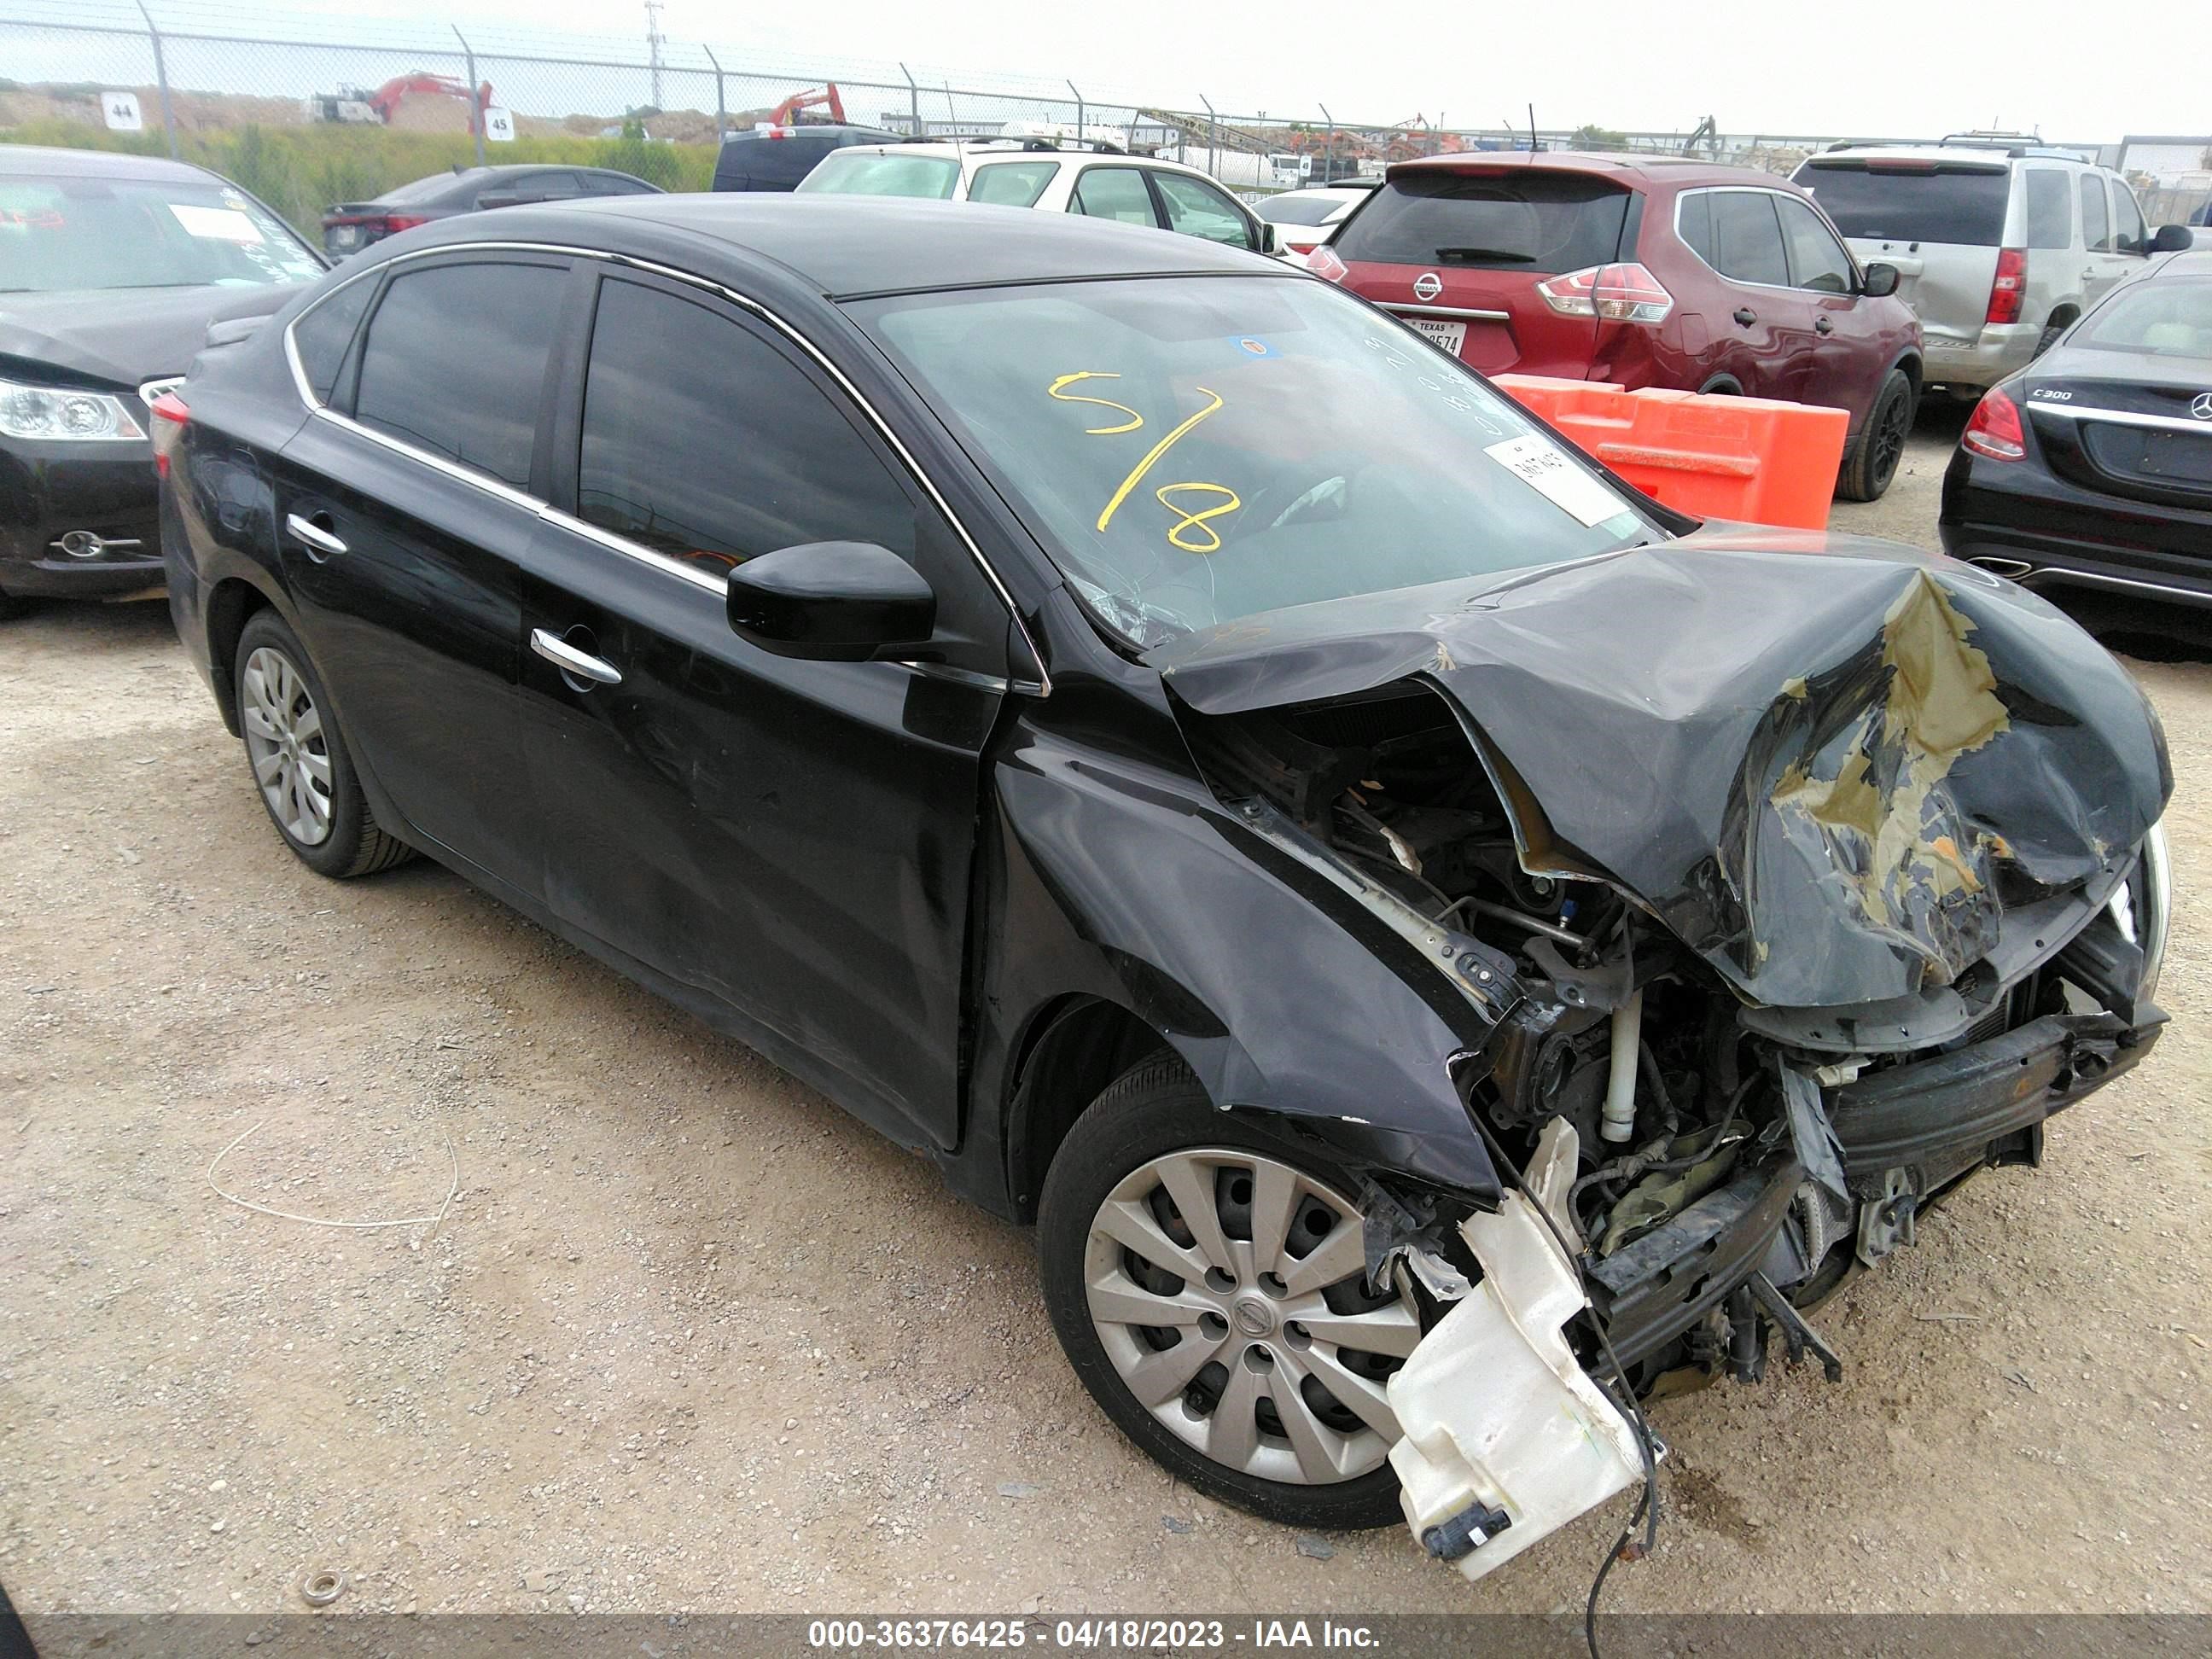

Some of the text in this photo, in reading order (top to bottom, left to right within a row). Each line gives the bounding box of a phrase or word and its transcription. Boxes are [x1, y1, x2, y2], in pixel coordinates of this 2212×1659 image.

[112, 104, 131, 117] 44
[492, 119, 507, 130] 45
[1419, 323, 1446, 332] TEXAS
